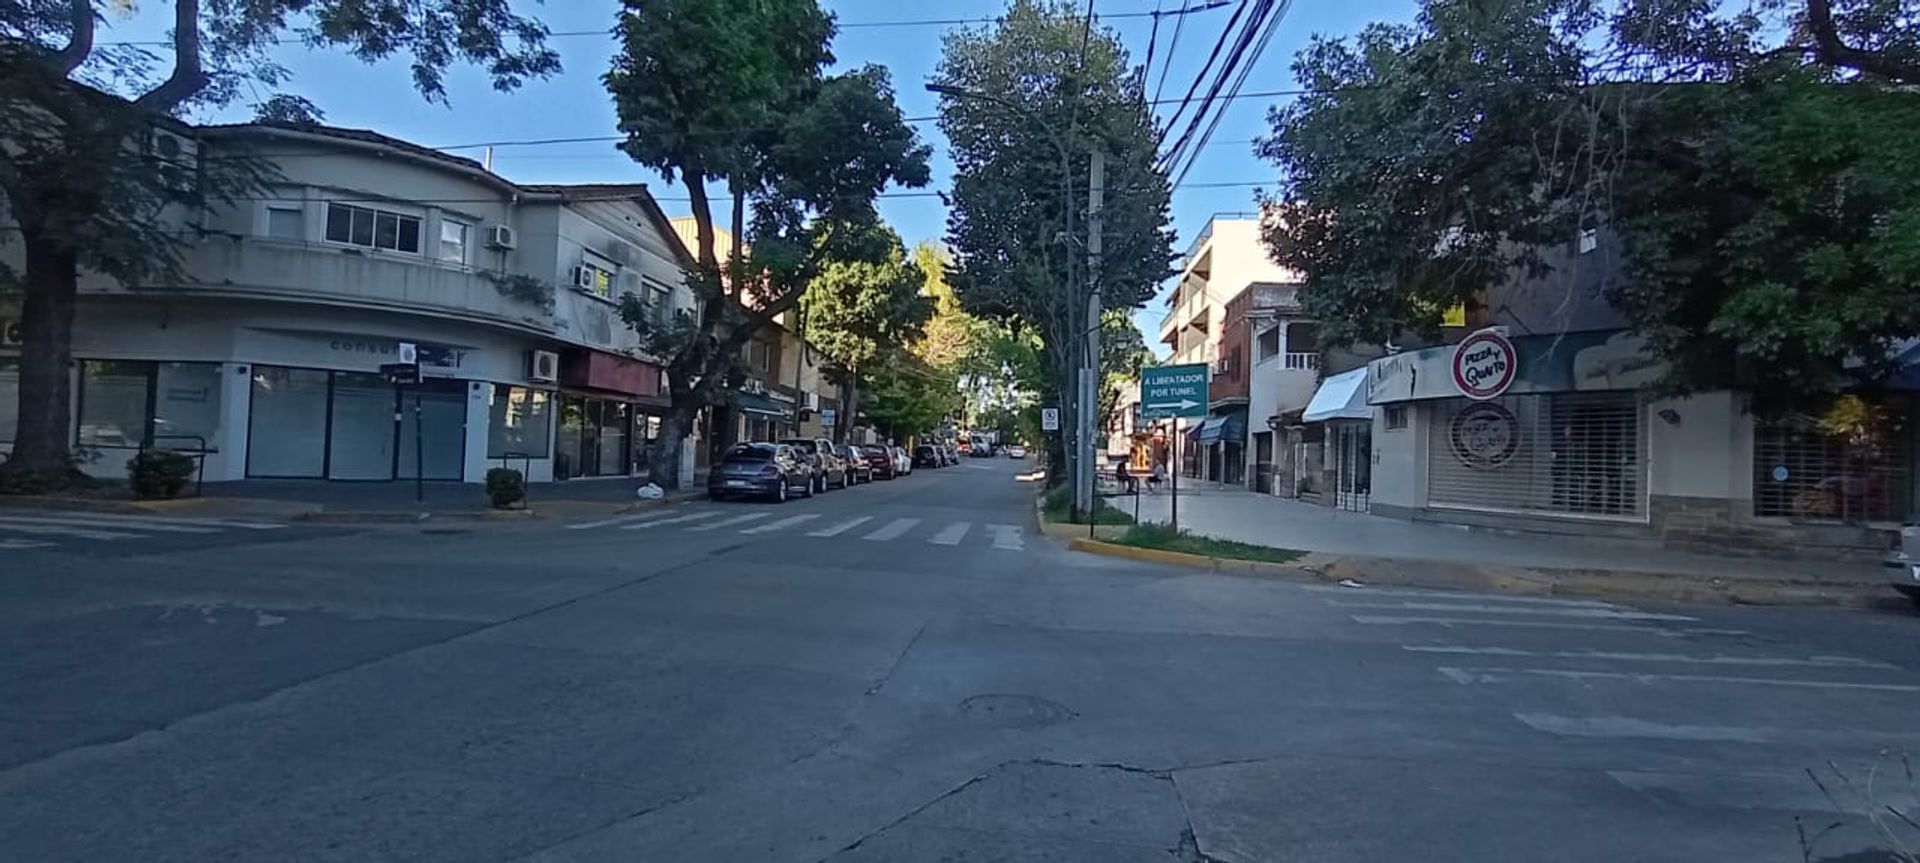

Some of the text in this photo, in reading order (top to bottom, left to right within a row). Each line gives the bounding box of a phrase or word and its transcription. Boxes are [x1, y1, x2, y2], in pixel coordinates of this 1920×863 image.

[1466, 347, 1492, 365] PIZZA
[1152, 374, 1204, 385] LIBERTADOR
[1151, 387, 1198, 397] POR TUNEL
